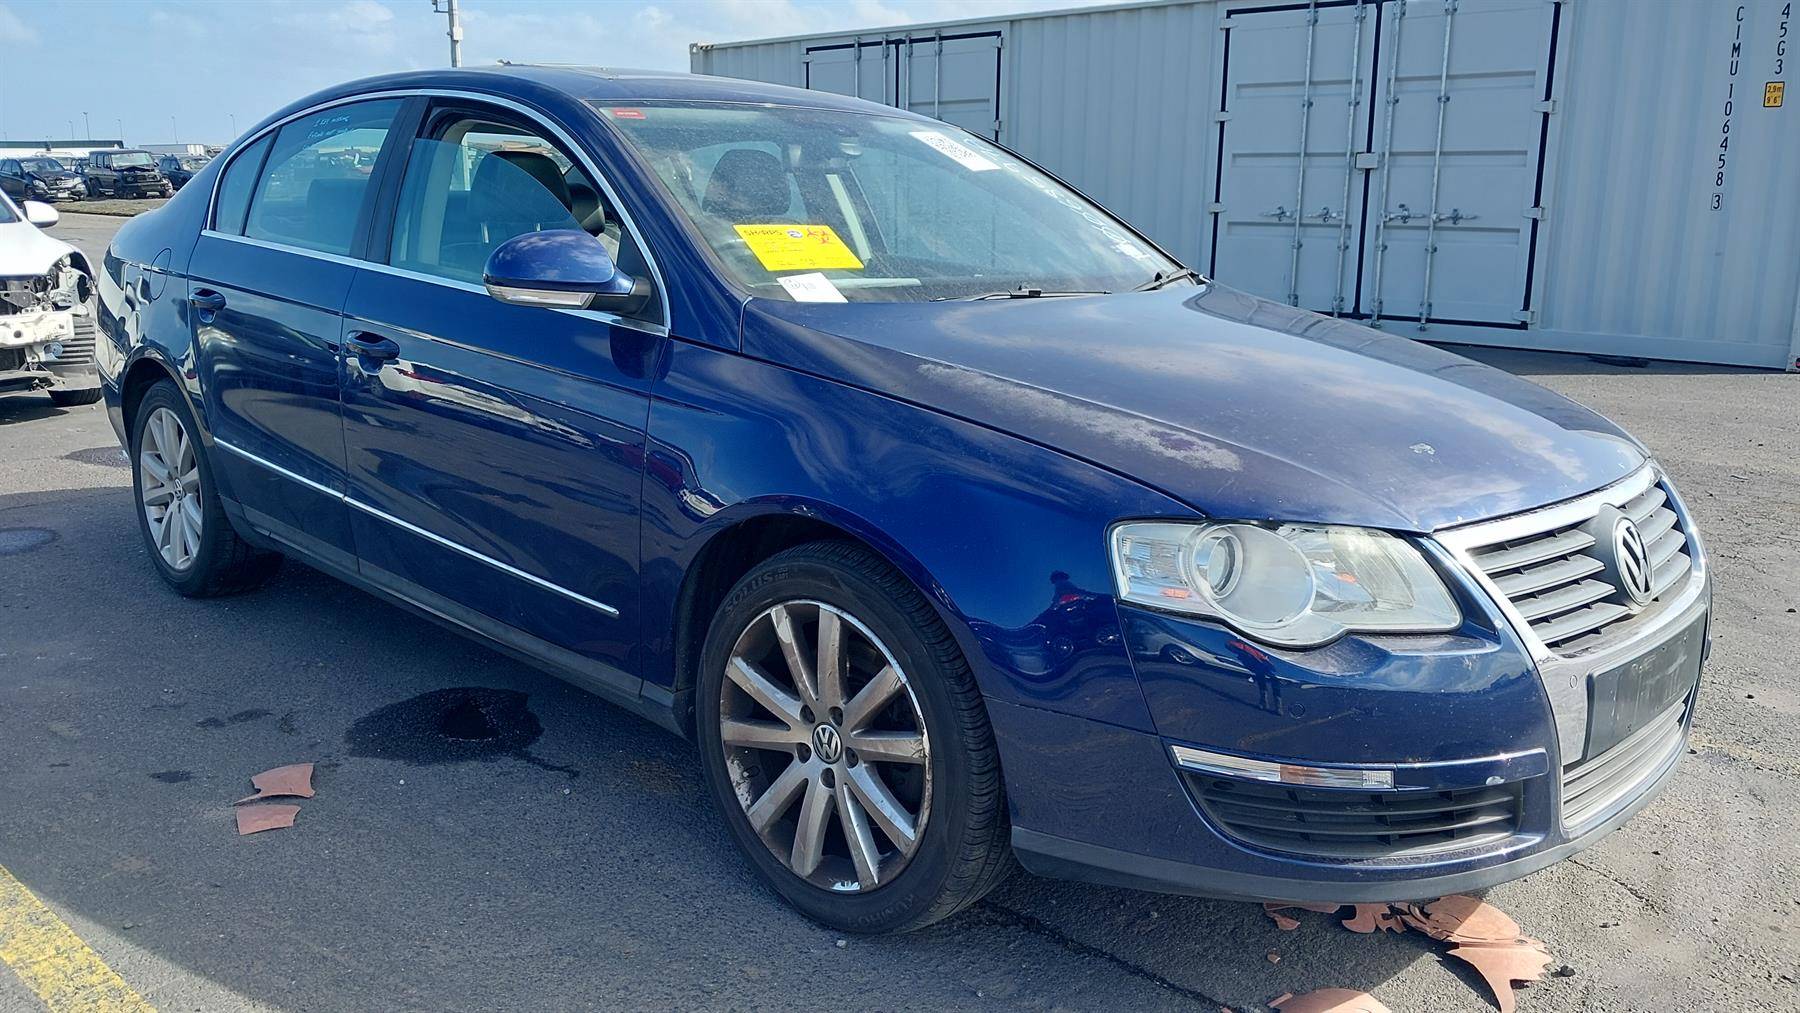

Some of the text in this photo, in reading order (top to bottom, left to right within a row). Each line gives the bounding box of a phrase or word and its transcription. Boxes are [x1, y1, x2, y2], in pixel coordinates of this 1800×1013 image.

[1712, 6, 1744, 210] CIMU 106458 3
[1774, 3, 1791, 75] 45G3
